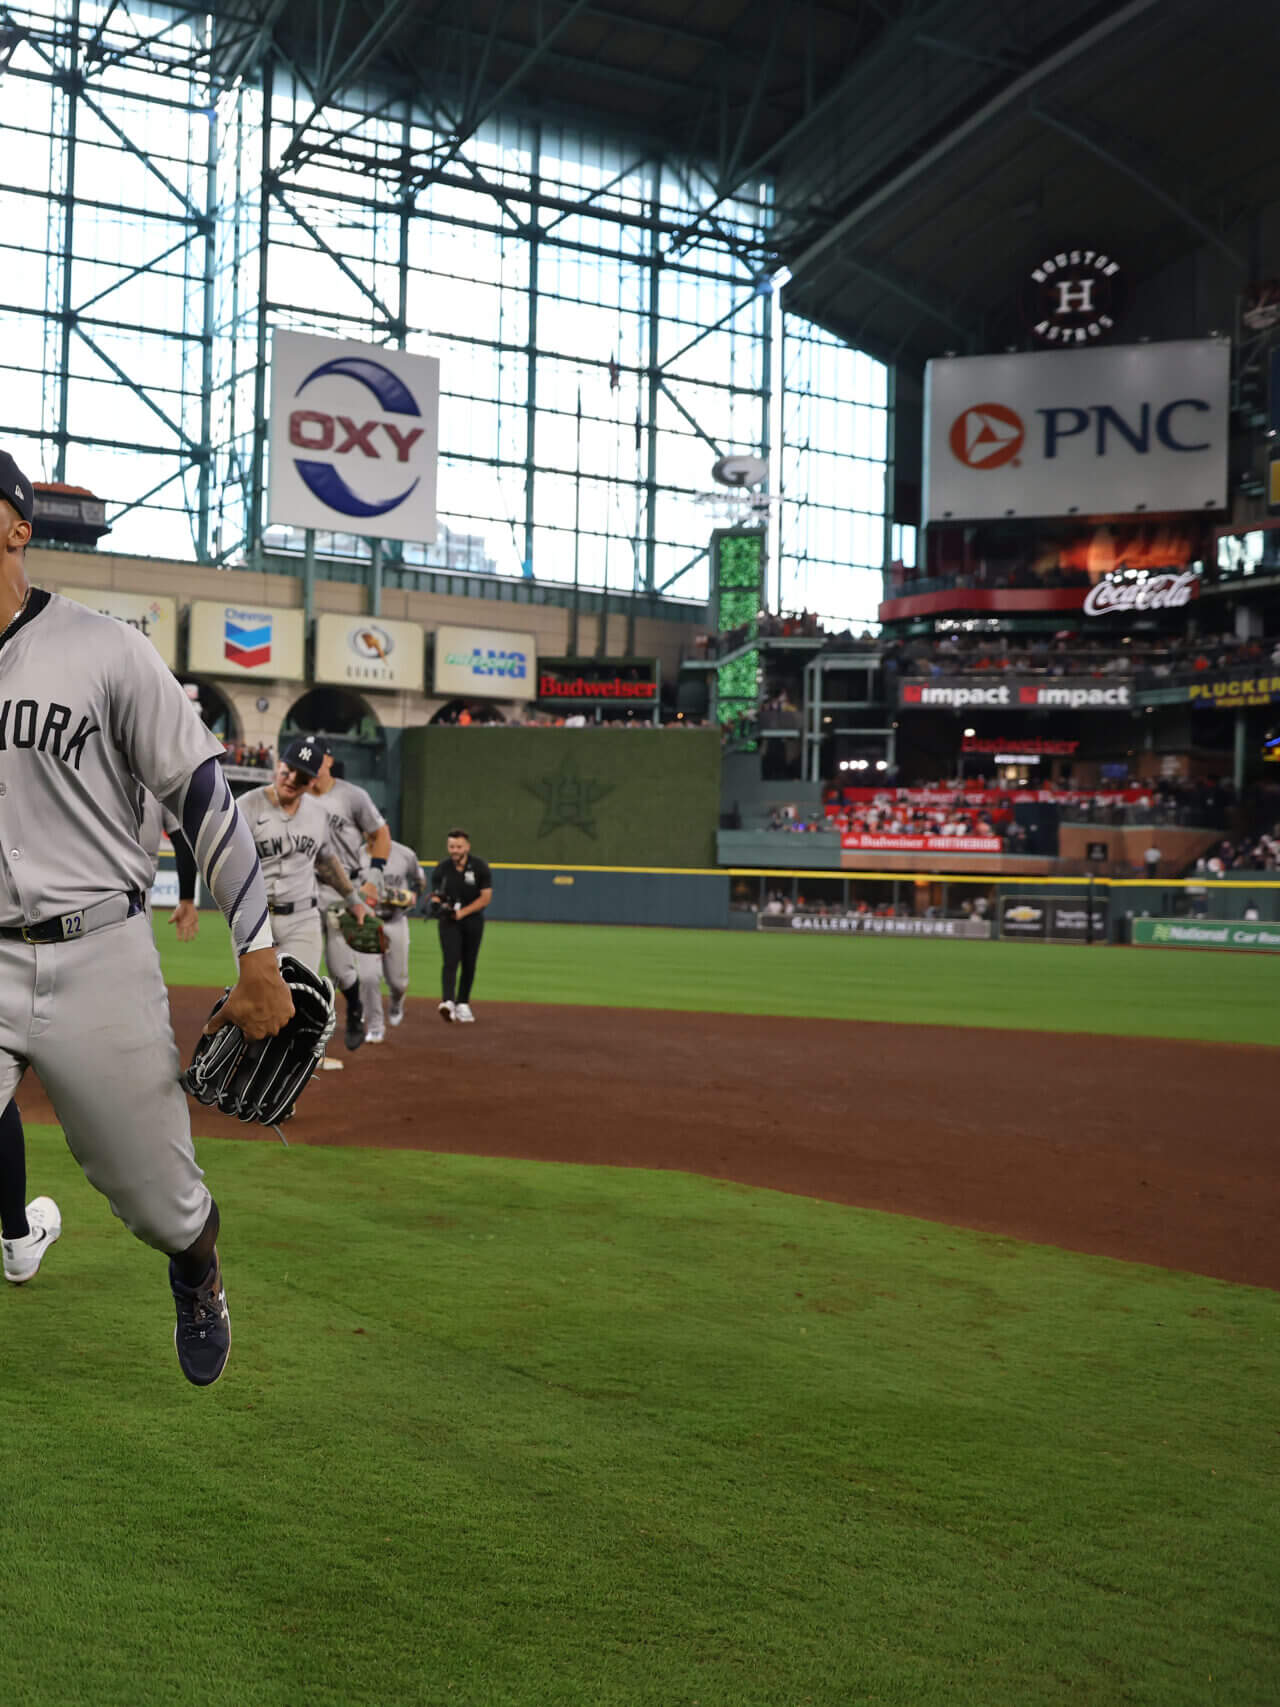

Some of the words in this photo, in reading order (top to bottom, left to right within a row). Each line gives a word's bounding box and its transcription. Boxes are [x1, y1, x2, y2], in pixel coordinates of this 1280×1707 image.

[1031, 251, 1120, 283] HOUSTON
[1056, 279, 1094, 313] H
[1033, 315, 1114, 342] ASTROS
[289, 410, 424, 463] OXY
[1035, 398, 1212, 459] PNC
[225, 608, 272, 622] Chevron
[472, 649, 527, 679] LNG
[539, 676, 658, 697] Budweiser
[921, 686, 1010, 707] impact
[1038, 685, 1129, 707] impact
[65, 916, 82, 934] 22
[791, 917, 858, 931] GALLERY
[863, 919, 955, 934] FURNITURE
[1170, 926, 1229, 941] National
[1233, 931, 1257, 943] Car
